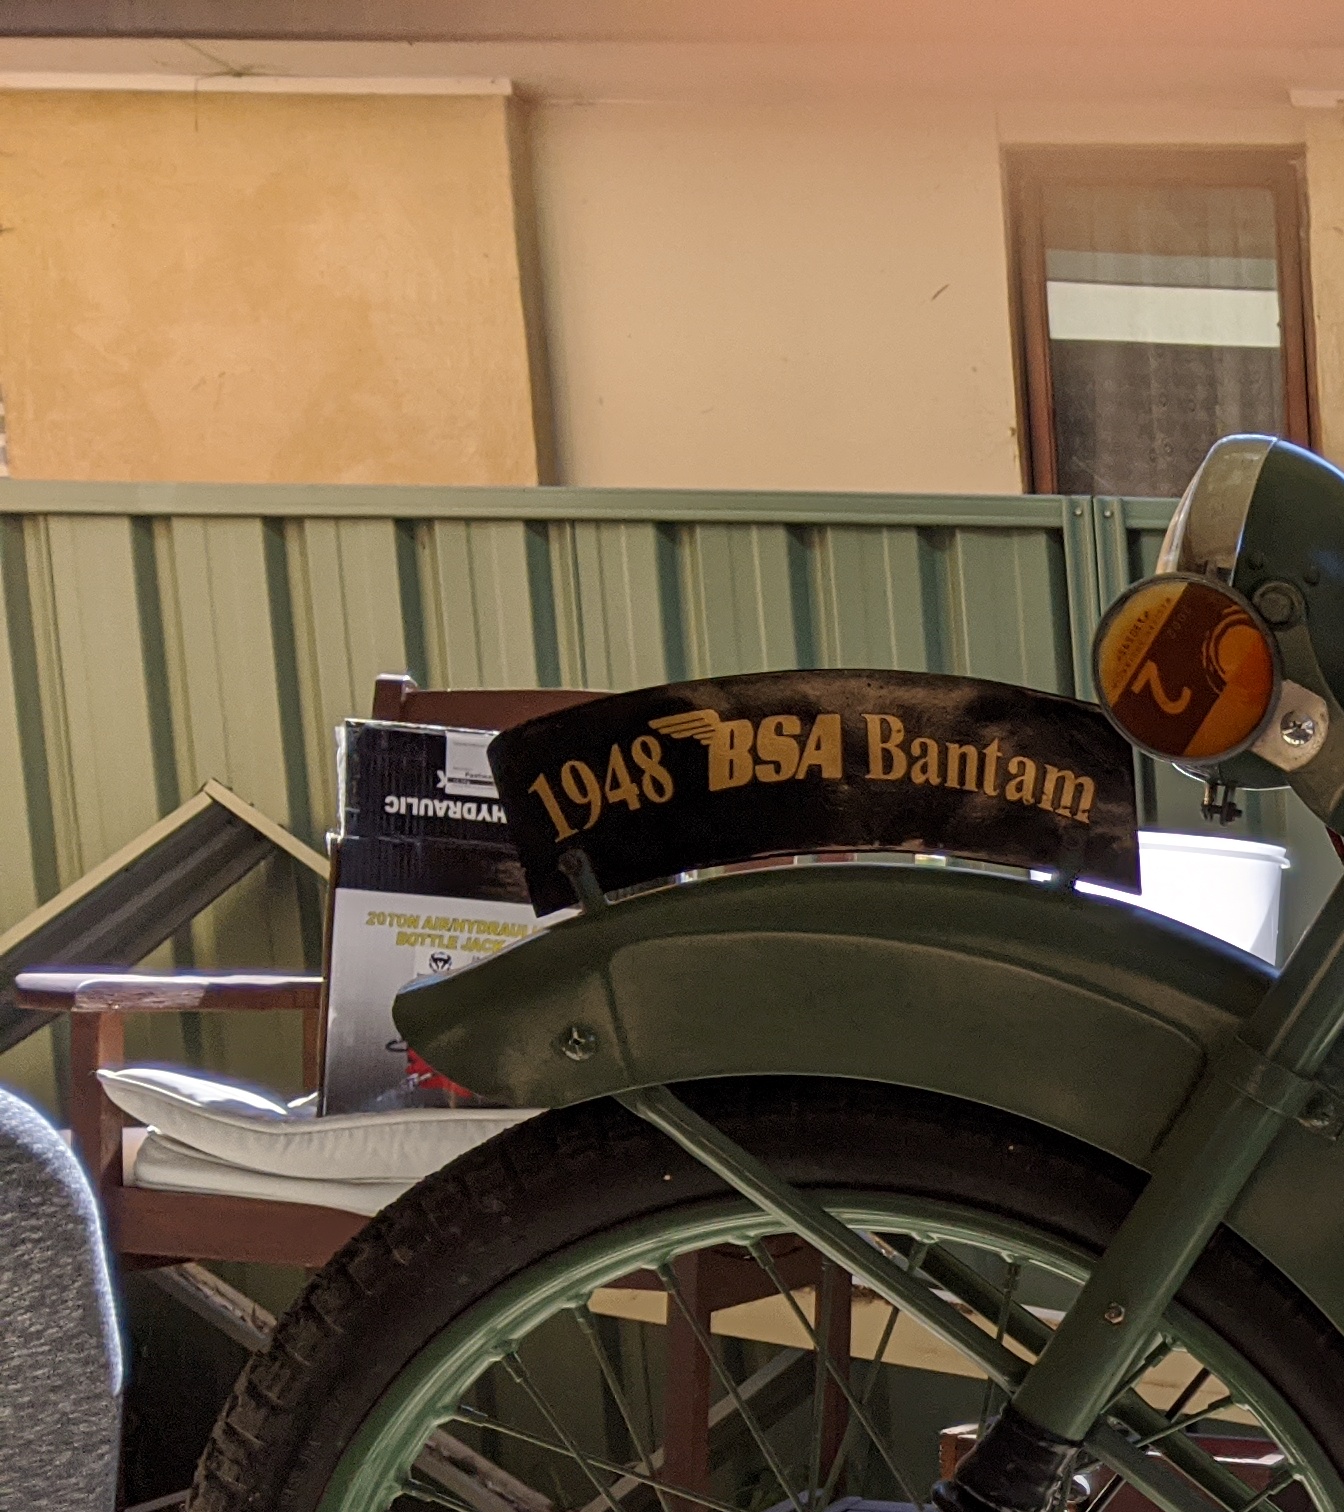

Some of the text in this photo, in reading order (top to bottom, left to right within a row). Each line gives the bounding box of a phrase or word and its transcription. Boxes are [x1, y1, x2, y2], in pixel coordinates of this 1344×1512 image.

[527, 711, 1095, 842] 1948 BSA Bantam
[384, 795, 508, 824] HYDRAULIC
[396, 931, 506, 954] BOTTLE JACK
